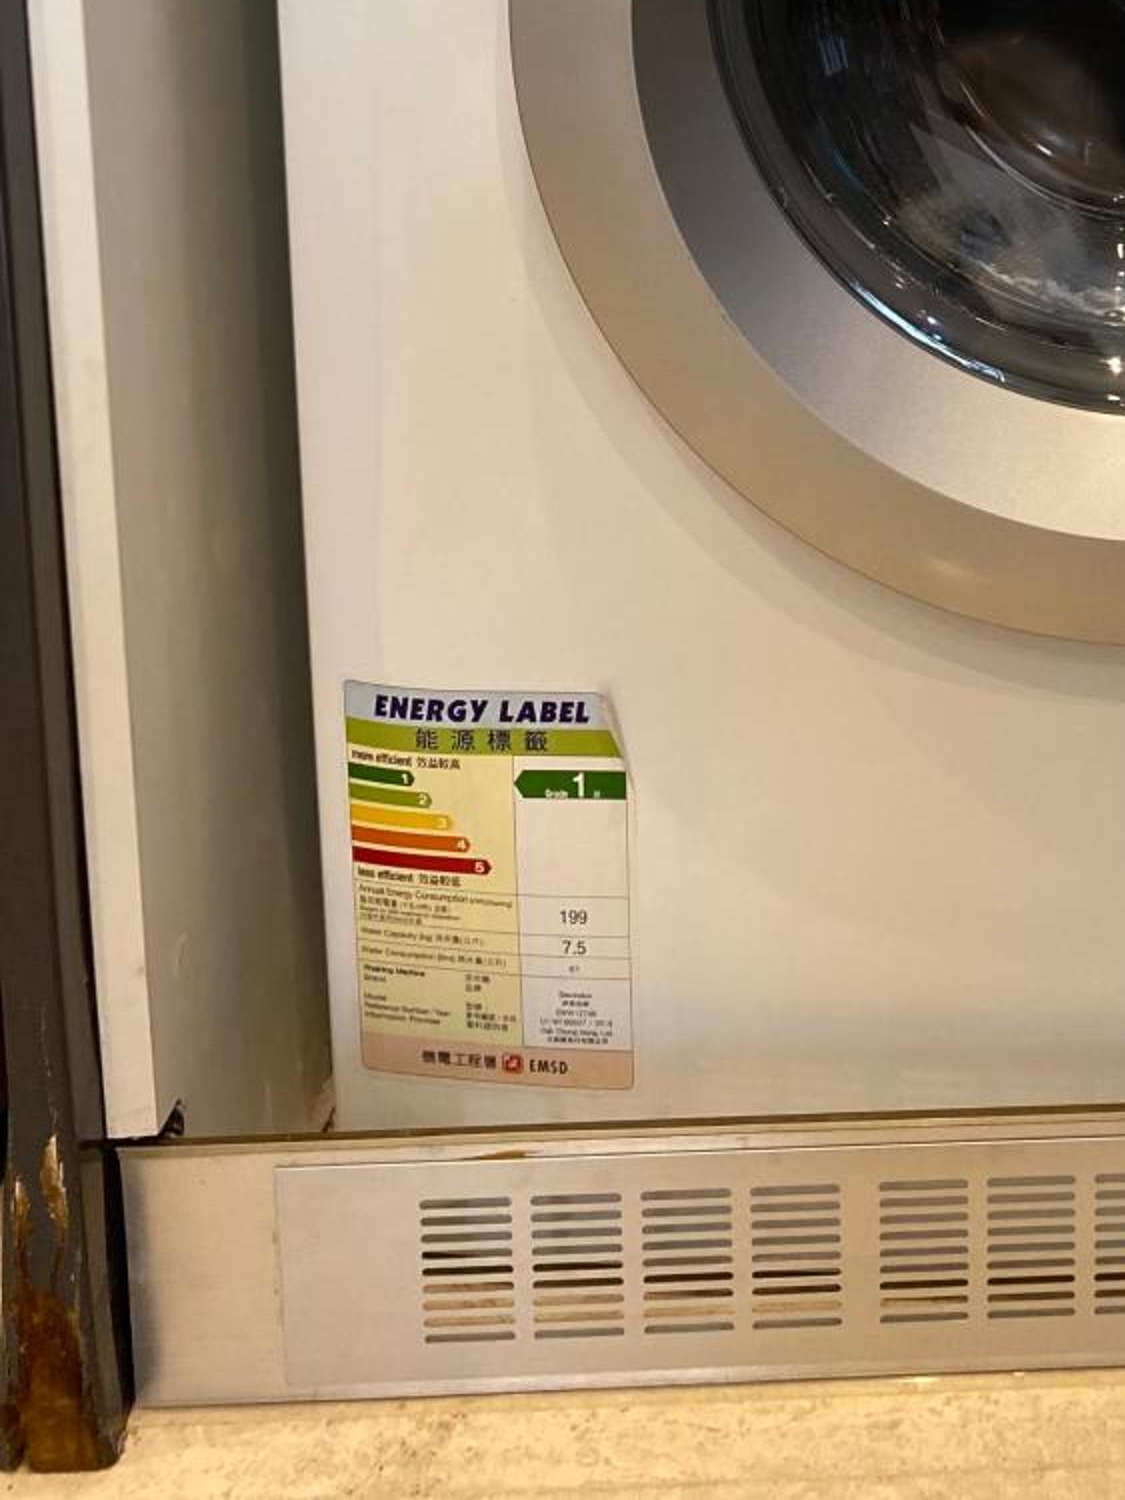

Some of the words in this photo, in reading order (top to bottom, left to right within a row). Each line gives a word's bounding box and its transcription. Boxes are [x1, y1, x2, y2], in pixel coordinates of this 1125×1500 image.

[374, 694, 487, 723] ENERGY
[499, 699, 589, 723] LABEL
[415, 728, 547, 751] 能源標籤
[351, 750, 374, 762] more
[375, 752, 412, 767] efficient
[400, 773, 409, 784] 1
[573, 772, 585, 798] 1
[418, 794, 428, 805] 2
[437, 817, 447, 828] 3
[457, 838, 466, 849] 4
[357, 867, 375, 879] less
[378, 870, 413, 883] efficient
[474, 861, 484, 873] 5
[358, 884, 385, 896] Annual
[386, 887, 413, 900] Energy
[415, 890, 469, 903] Consumption
[559, 909, 588, 925] 199
[562, 940, 587, 955] 7.5
[528, 1059, 569, 1075] EMSD
